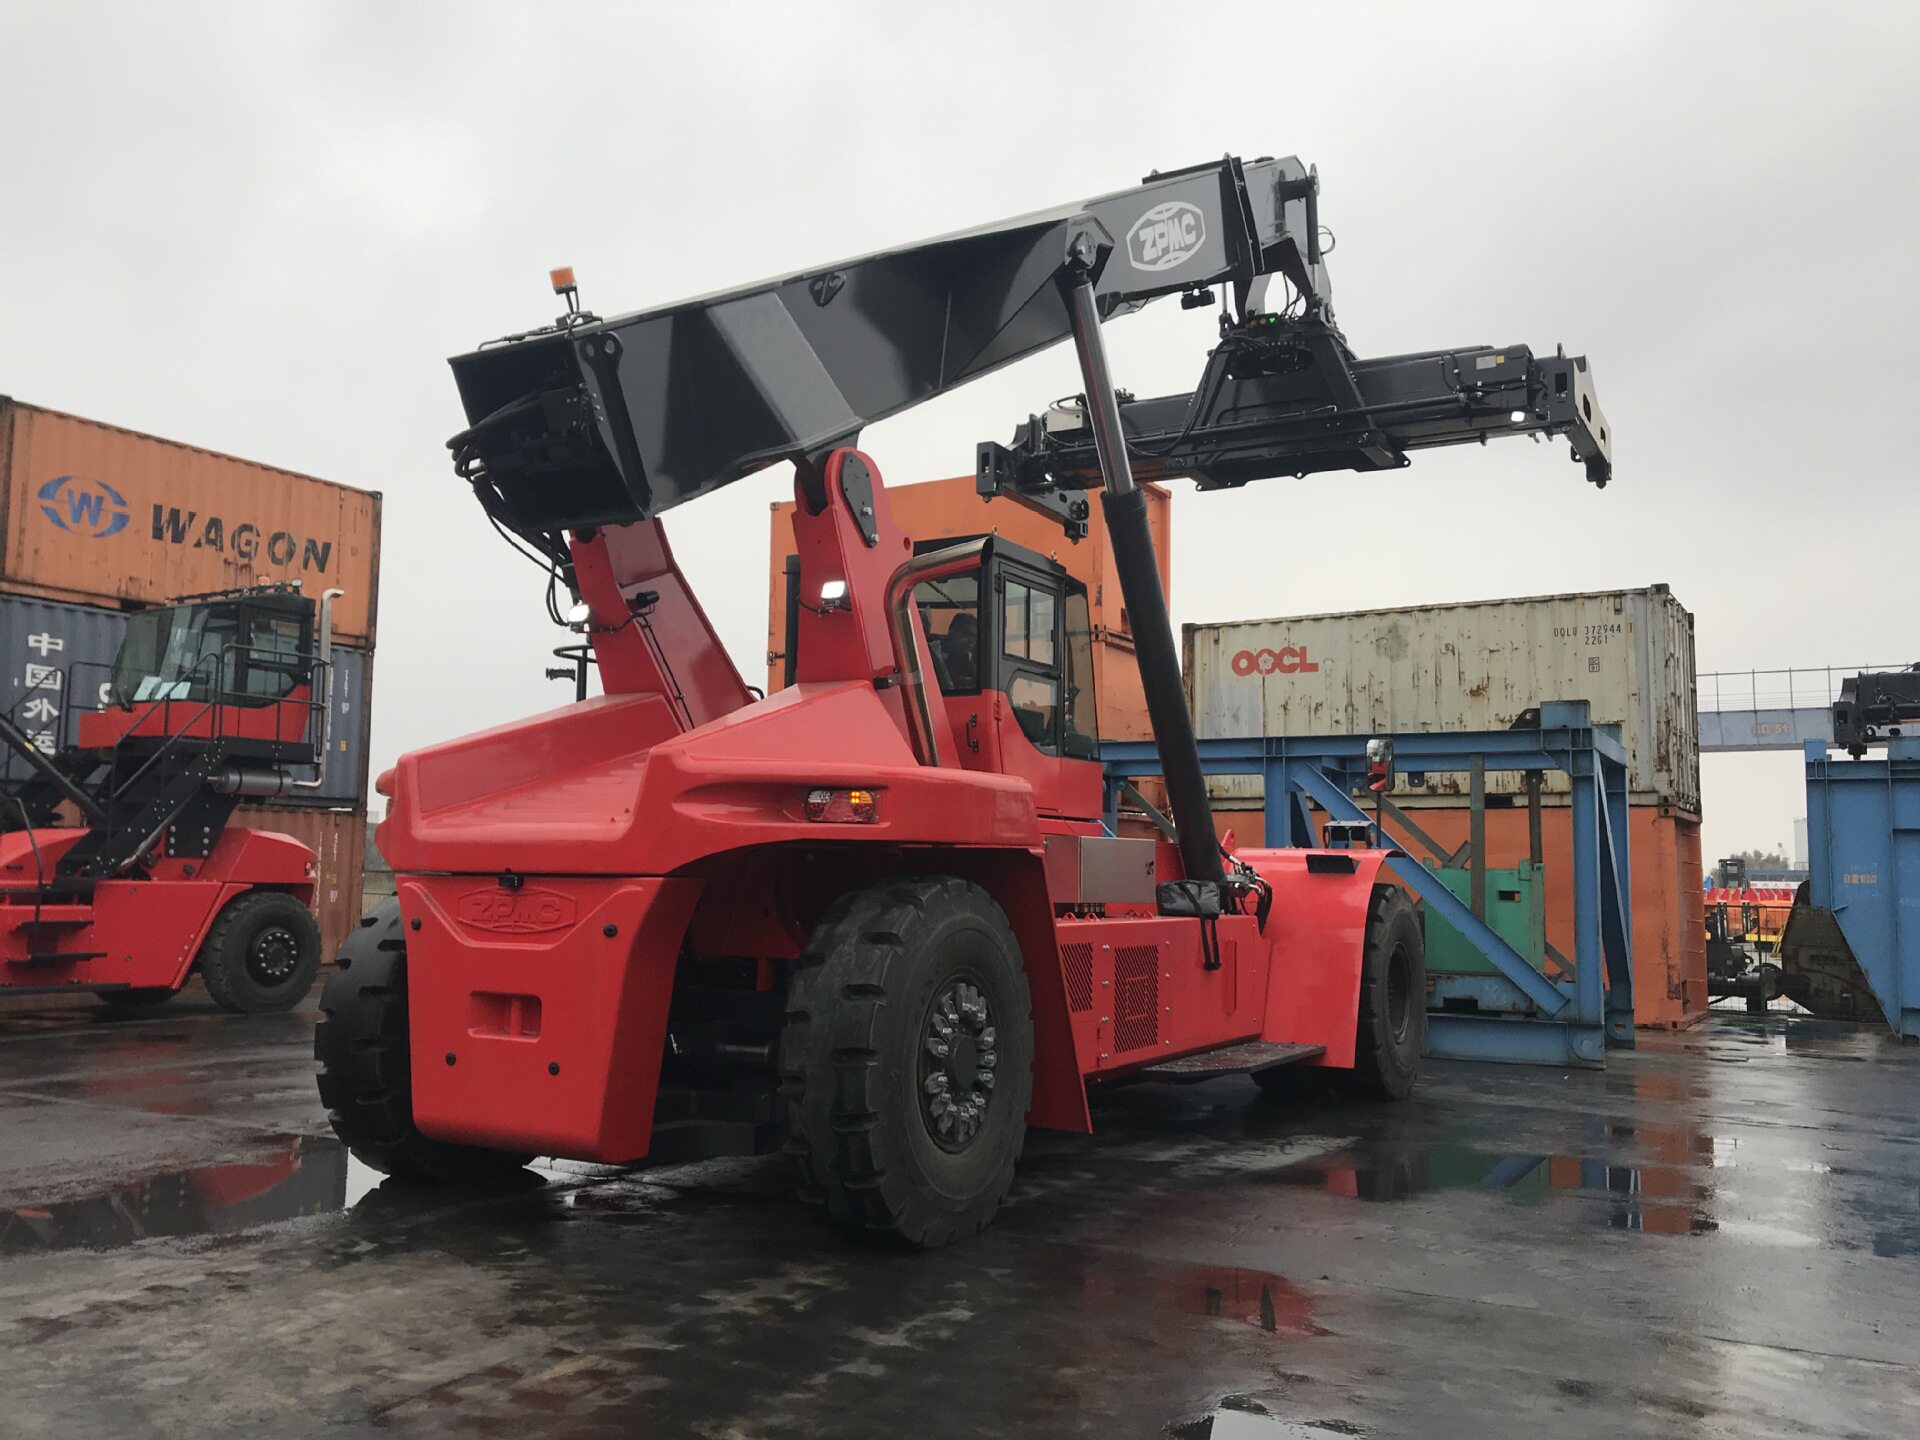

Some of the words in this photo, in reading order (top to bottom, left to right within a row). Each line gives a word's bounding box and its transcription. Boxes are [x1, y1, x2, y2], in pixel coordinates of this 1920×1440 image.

[1139, 213, 1197, 262] ZPMC
[152, 504, 332, 573] WAGON
[1231, 645, 1320, 677] OOCL
